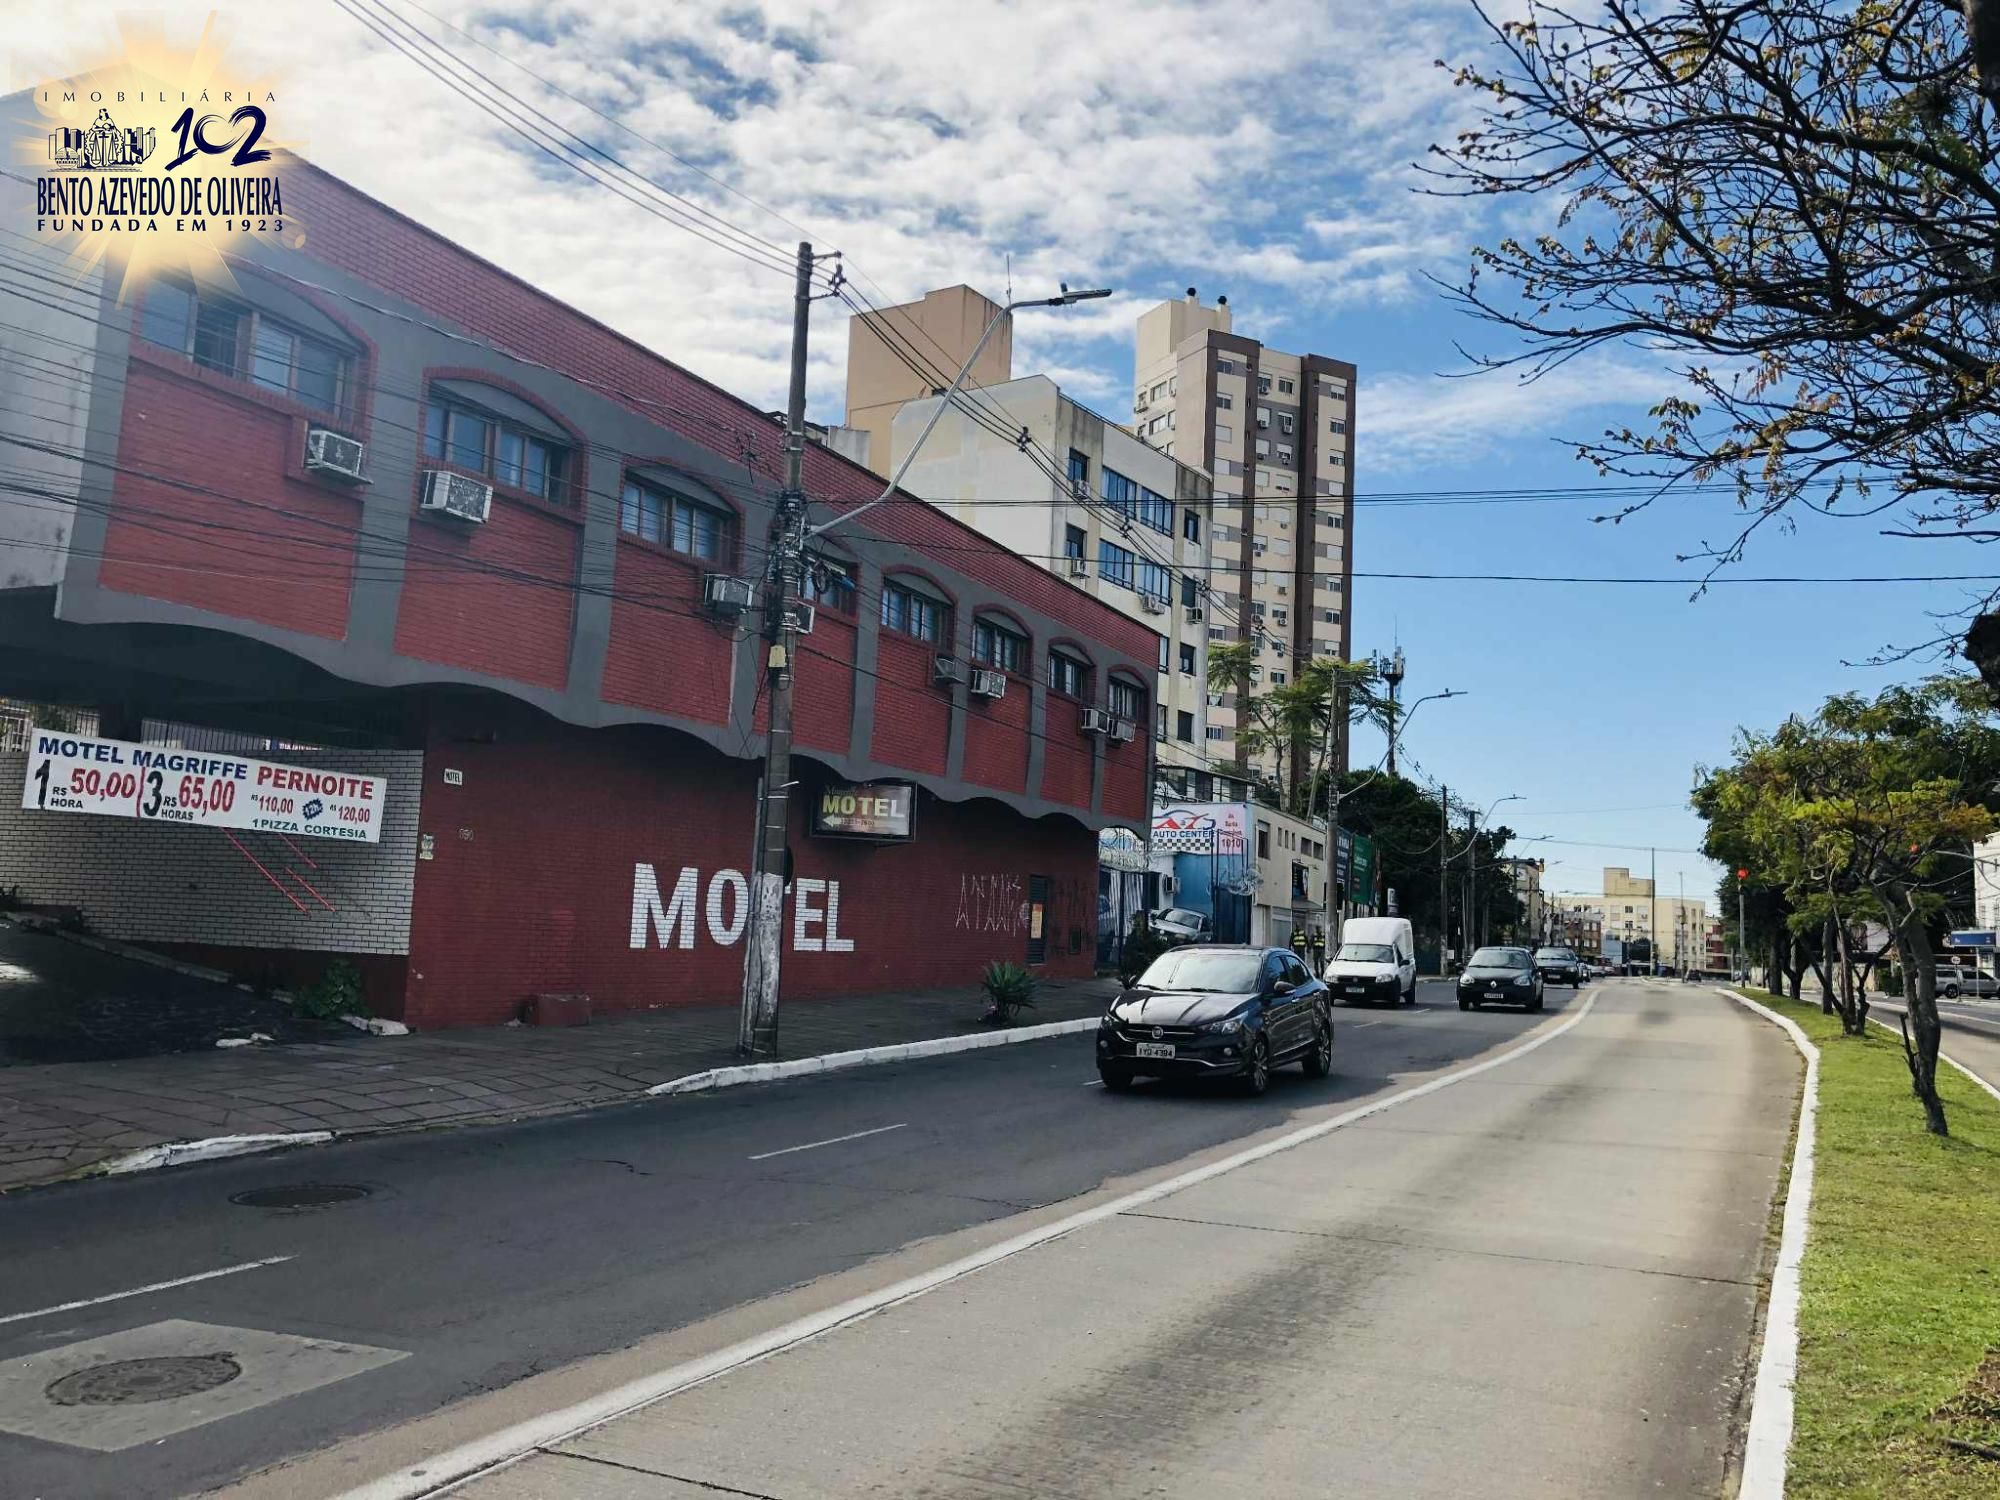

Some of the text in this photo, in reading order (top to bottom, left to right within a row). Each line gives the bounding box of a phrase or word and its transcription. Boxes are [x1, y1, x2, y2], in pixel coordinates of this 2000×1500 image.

[38, 737, 248, 779] MOTEL MAGRIFFE
[35, 759, 51, 810] 1
[70, 767, 136, 802] 50,00
[257, 766, 374, 800] PERNOITE
[446, 771, 461, 783] MOTEL
[50, 798, 83, 809] HORA
[143, 770, 164, 817] 3
[179, 775, 235, 817] 65,00
[161, 809, 194, 821] HORAS
[259, 795, 294, 816] 110,00
[338, 806, 371, 825] 120,00
[822, 794, 905, 818] MOTEL
[252, 818, 367, 839] 1 PIZZA CORTESIA
[629, 862, 855, 953] MOEL
